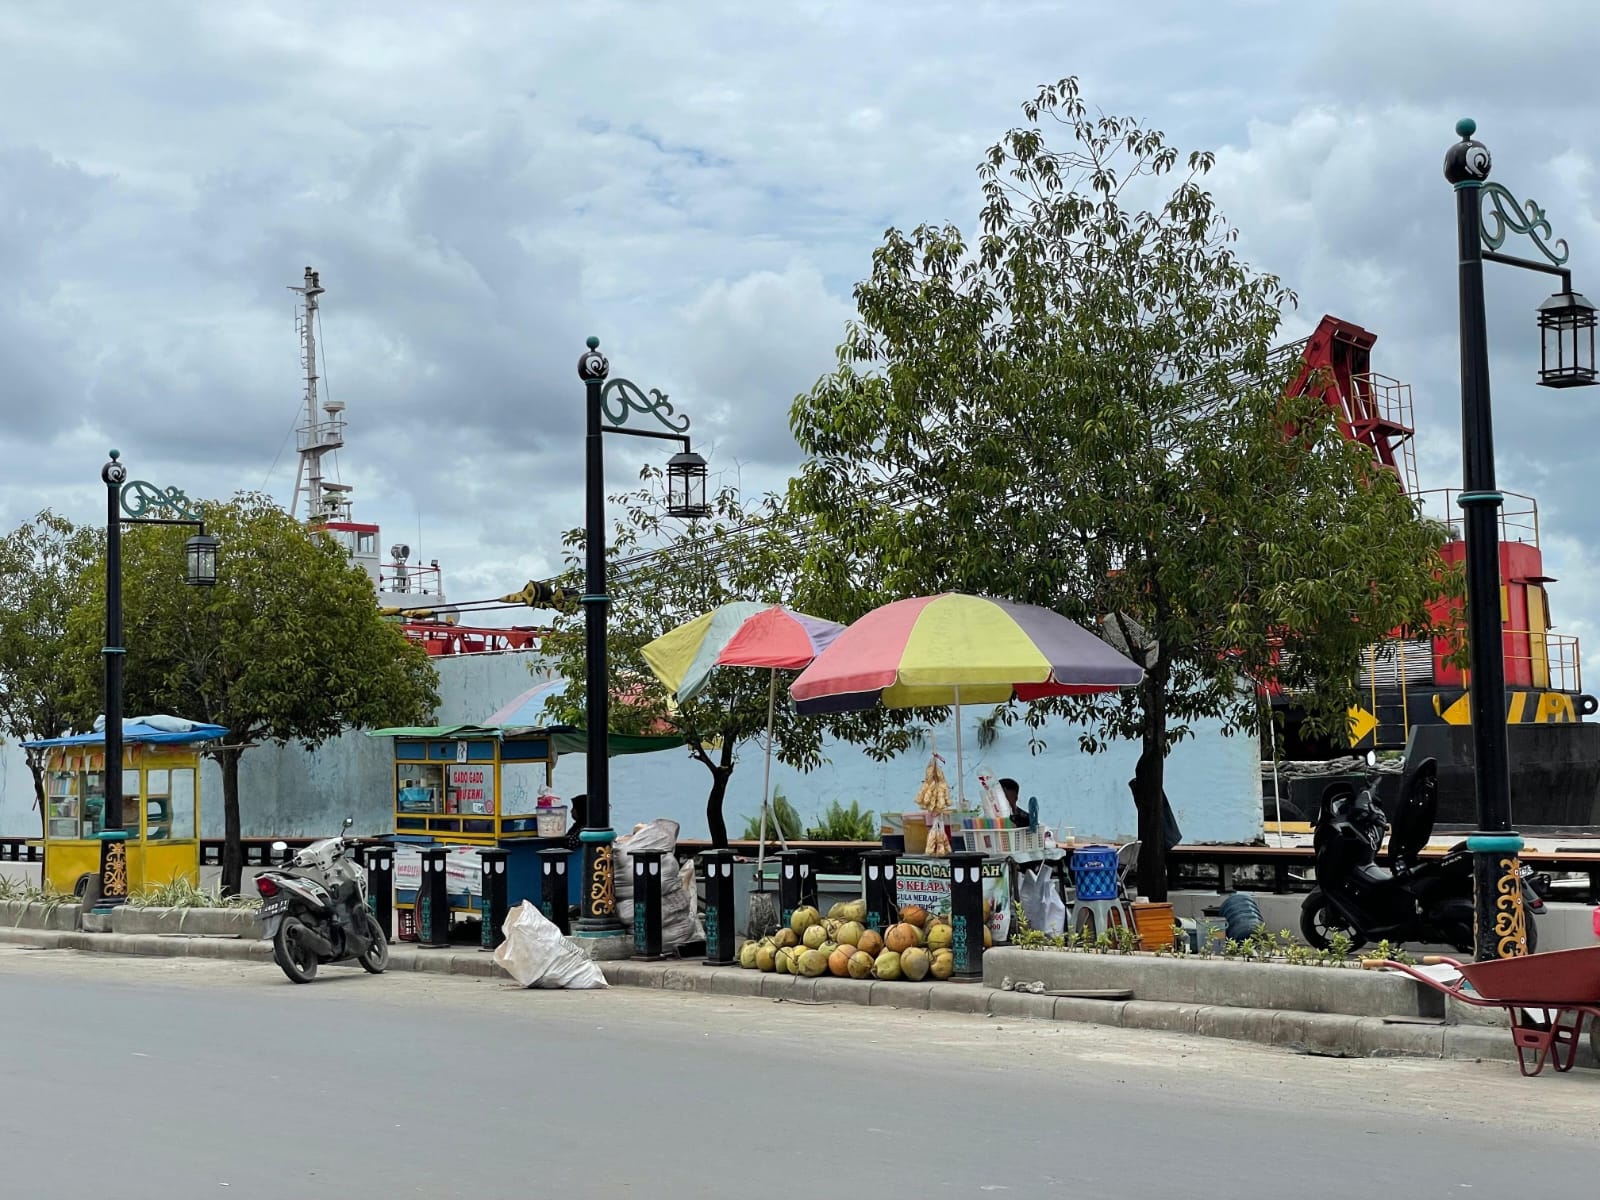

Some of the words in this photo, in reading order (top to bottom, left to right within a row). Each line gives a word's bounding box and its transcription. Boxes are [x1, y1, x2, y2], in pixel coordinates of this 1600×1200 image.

[454, 771, 467, 783] GADO
[469, 771, 483, 783] GADO
[896, 864, 930, 877] RUNG
[906, 880, 945, 892] KELAPA
